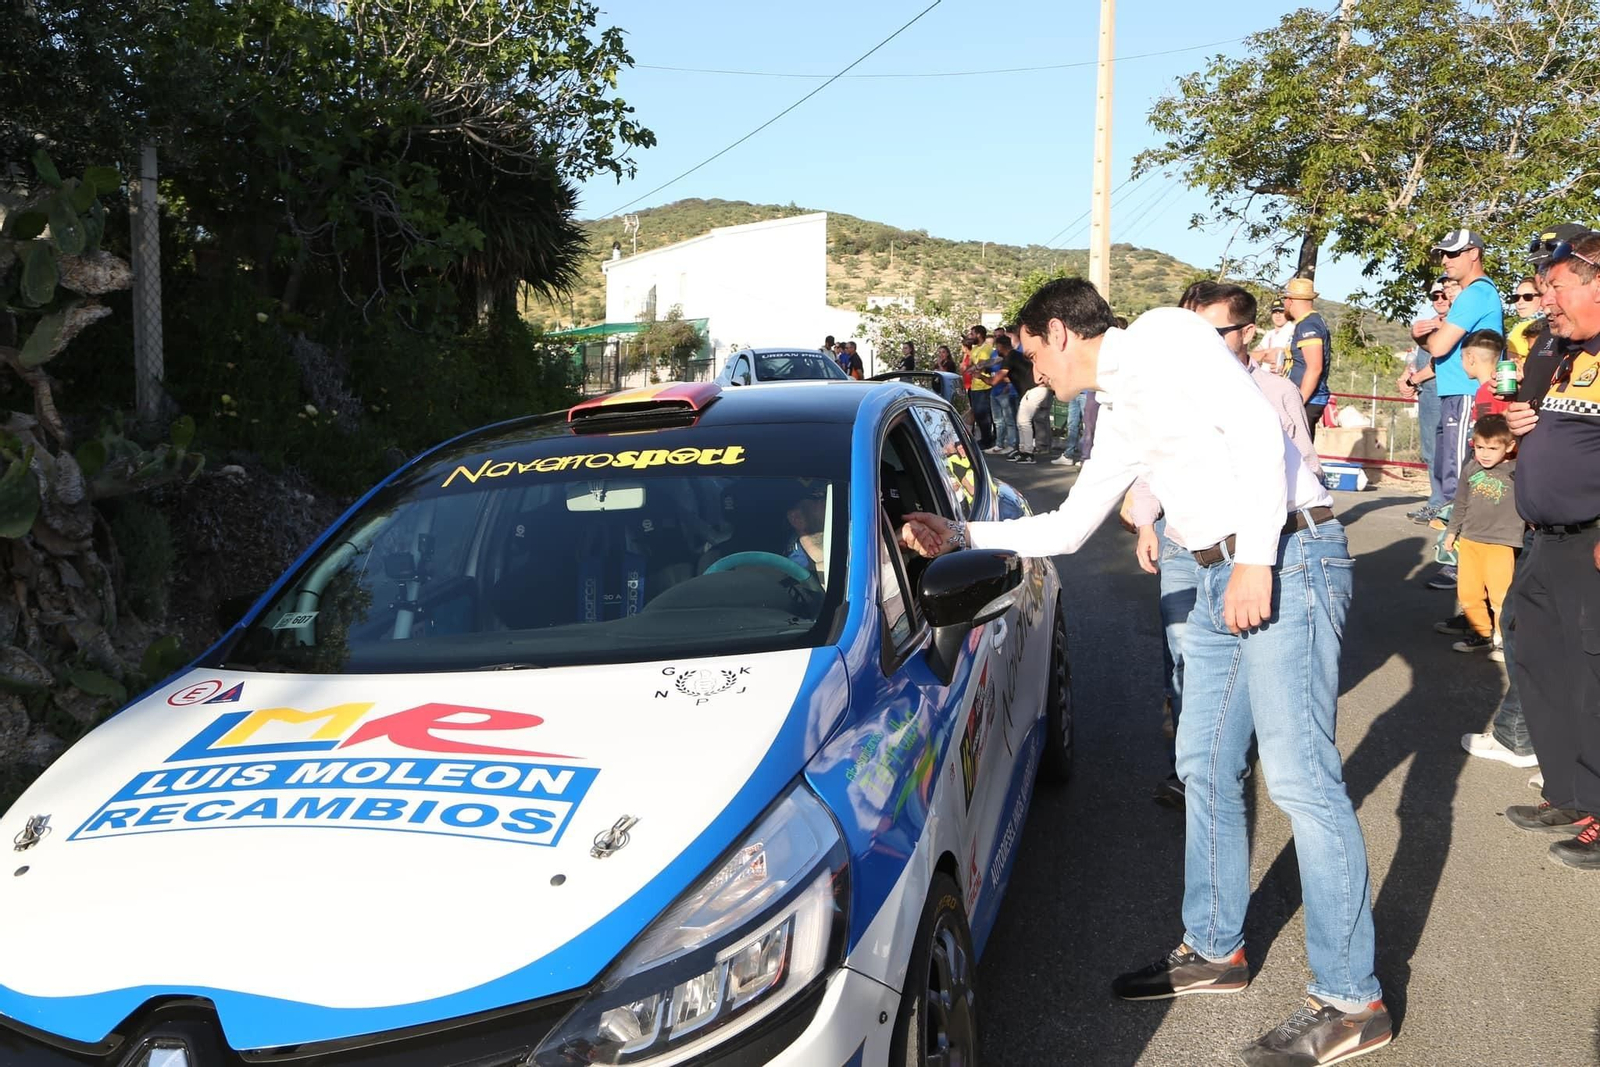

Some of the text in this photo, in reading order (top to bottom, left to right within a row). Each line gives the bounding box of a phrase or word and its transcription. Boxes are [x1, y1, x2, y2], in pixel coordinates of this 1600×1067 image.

[291, 615, 313, 625] 607
[135, 760, 575, 795] LUIS MOLEON
[85, 796, 560, 835] RECAMBIOS
